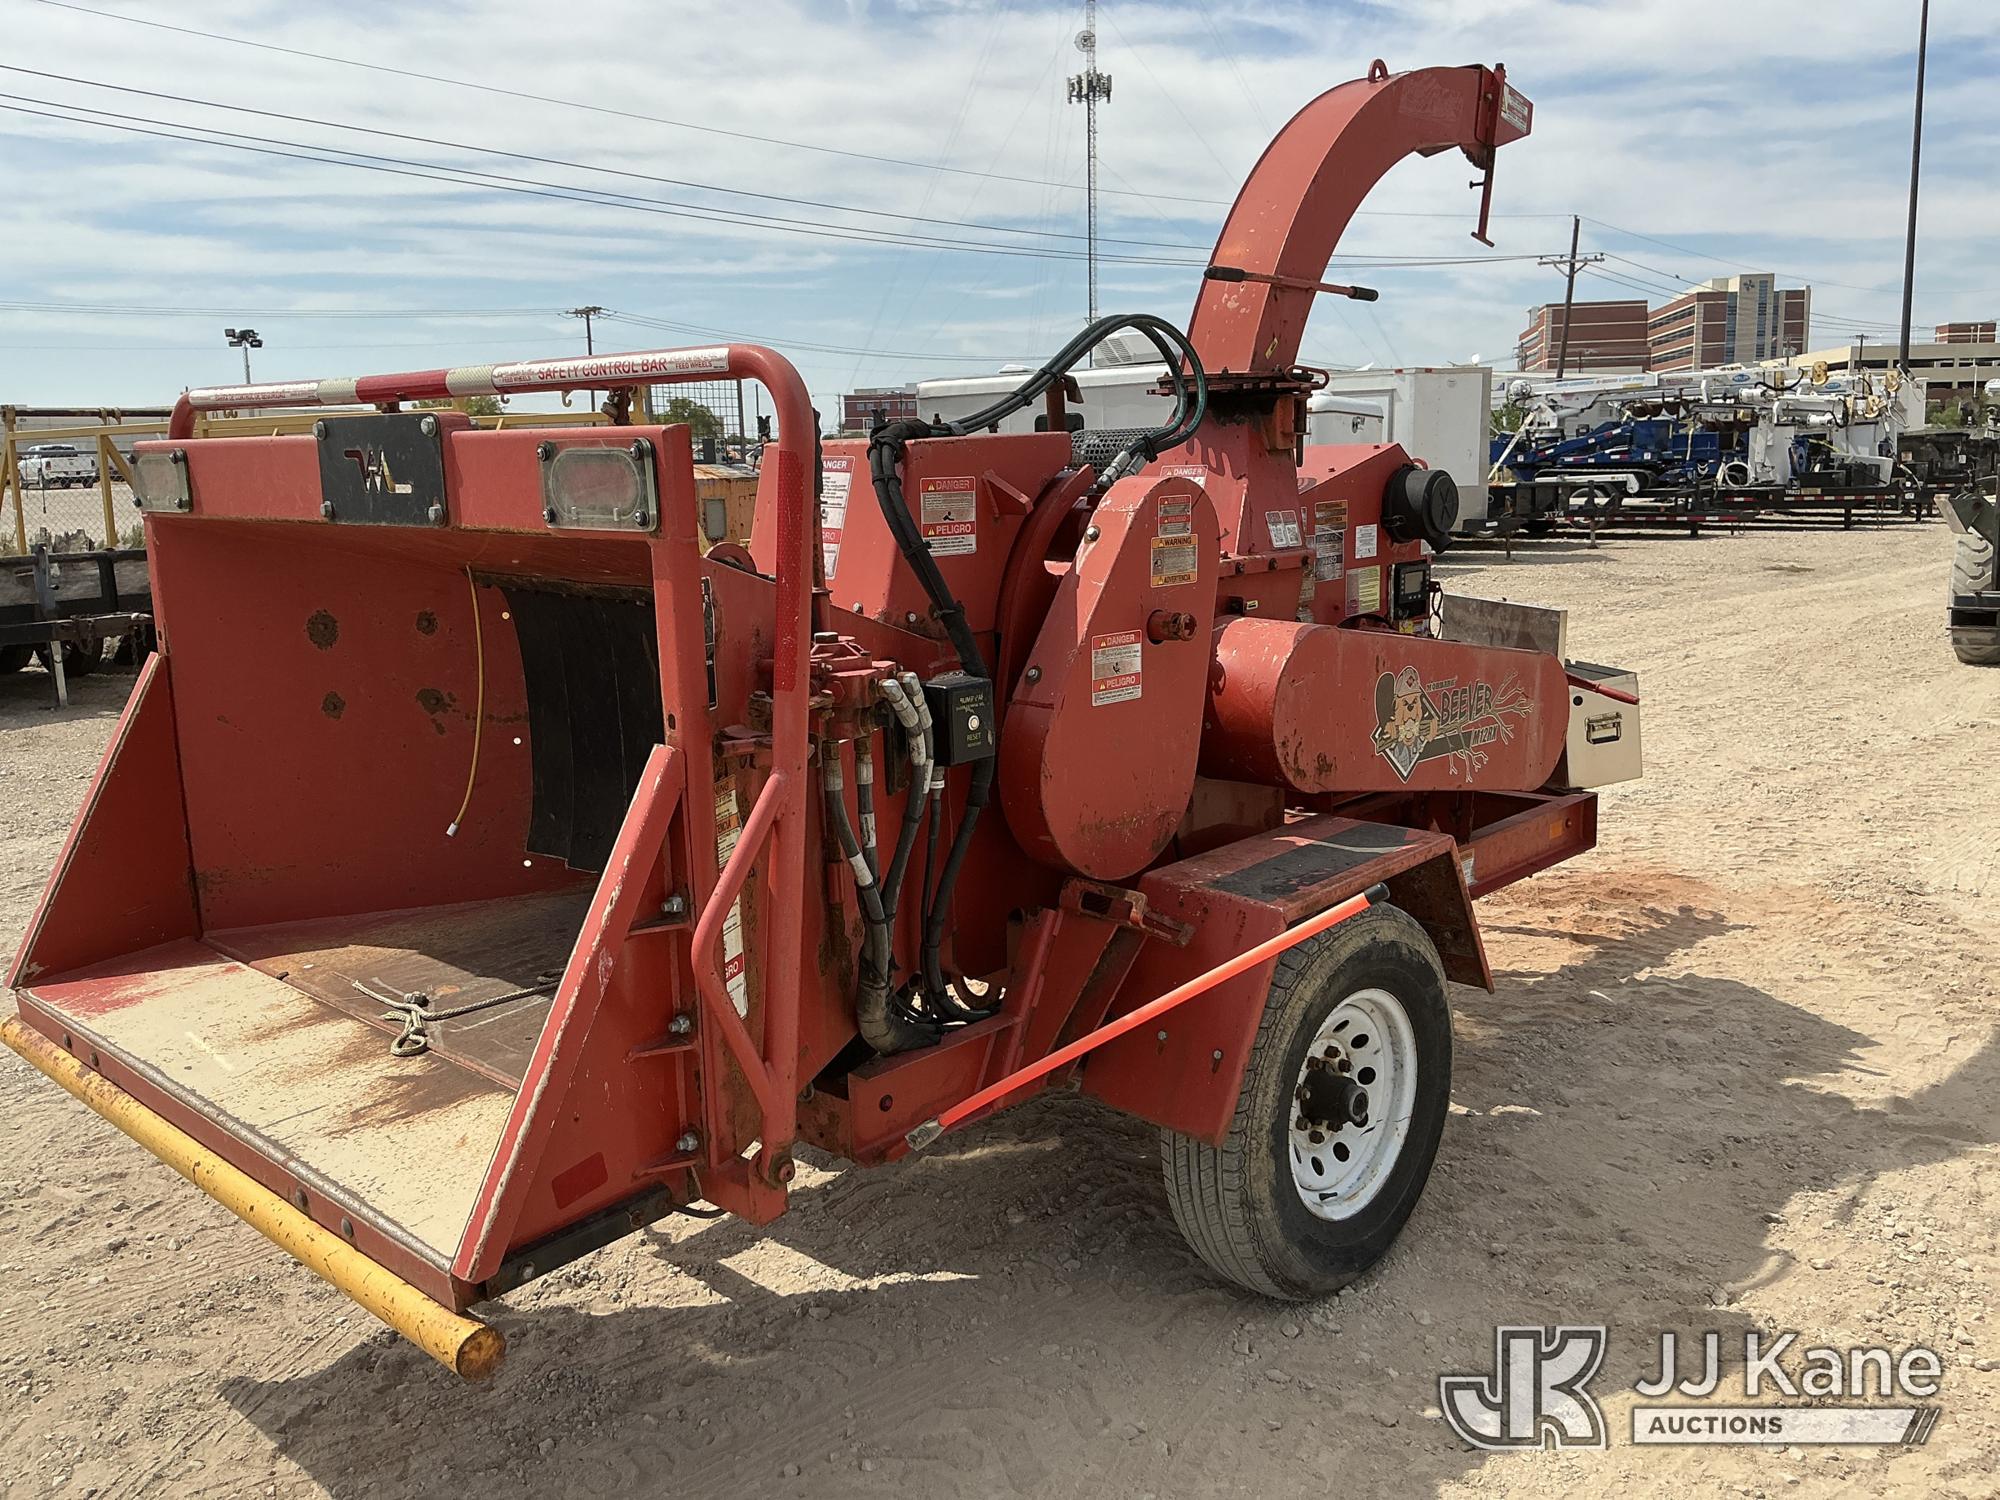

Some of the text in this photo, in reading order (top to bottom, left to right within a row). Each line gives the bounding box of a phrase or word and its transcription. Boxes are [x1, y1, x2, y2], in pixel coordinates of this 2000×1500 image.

[538, 363, 580, 381] SAFETY
[582, 359, 639, 377] CONTROL
[642, 358, 668, 372] BAR
[675, 362, 690, 370] FEED
[690, 360, 713, 369] WHEELS
[822, 460, 847, 469] ANGER
[1173, 468, 1202, 476] DANGER
[935, 480, 970, 491] DANGER
[936, 523, 972, 535] PELIGRO
[1164, 537, 1192, 547] WARNING
[1106, 634, 1135, 646] DANGER
[1106, 675, 1136, 689] PELIGRO
[1440, 680, 1493, 728] BEEVER
[966, 732, 981, 742] RESET
